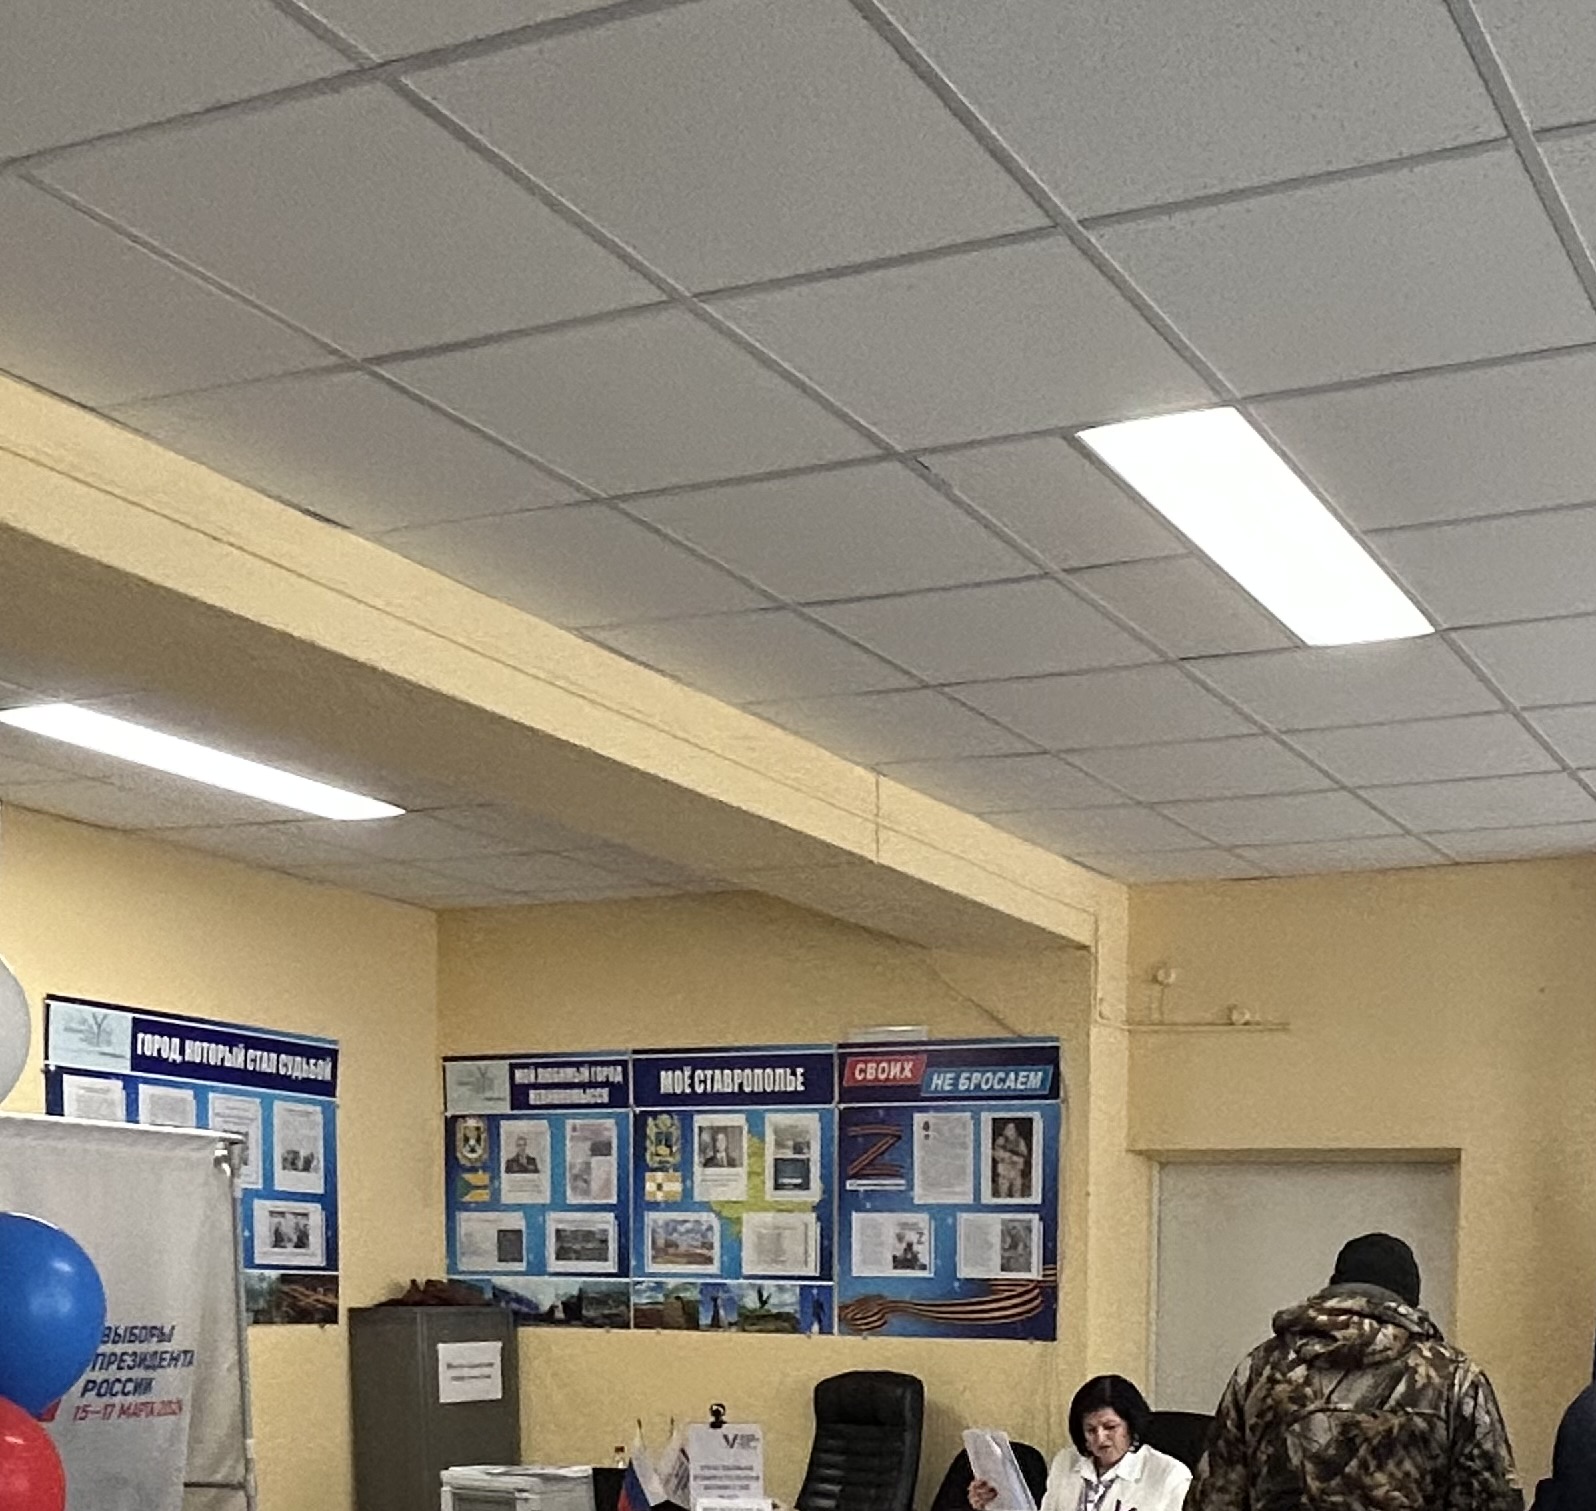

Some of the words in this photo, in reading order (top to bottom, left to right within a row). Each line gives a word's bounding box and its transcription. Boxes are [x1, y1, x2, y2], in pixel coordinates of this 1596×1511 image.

[136, 1032, 183, 1064] ГОРОД,
[184, 1040, 245, 1069] КОТОРЫЙ
[246, 1049, 277, 1074] СТАЛ
[278, 1054, 333, 1081] СУДЬБОЙ
[660, 1066, 692, 1094] МОЁ
[694, 1068, 805, 1094] СТАВРОПОЛЬЕ
[854, 1061, 914, 1080] СВОИХ
[930, 1072, 955, 1091] НЕ
[958, 1071, 1043, 1091] БРОСАЕМ
[81, 1378, 155, 1398] РОССИИ
